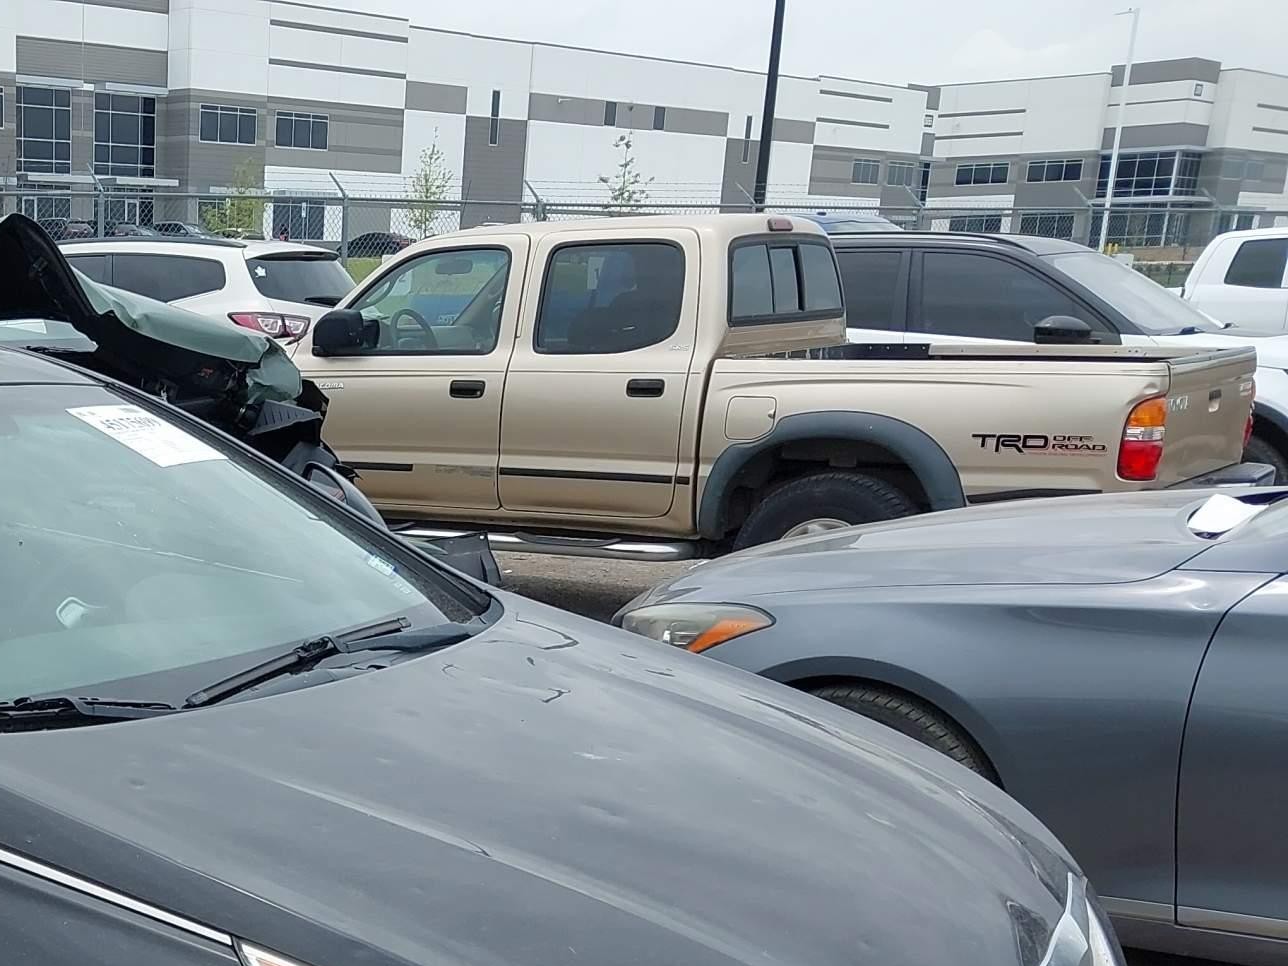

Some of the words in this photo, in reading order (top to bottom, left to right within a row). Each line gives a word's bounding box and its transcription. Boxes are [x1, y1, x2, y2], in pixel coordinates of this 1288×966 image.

[972, 433, 1049, 453] TRD
[1053, 435, 1093, 443] OFF
[1052, 443, 1107, 451] ROAD
